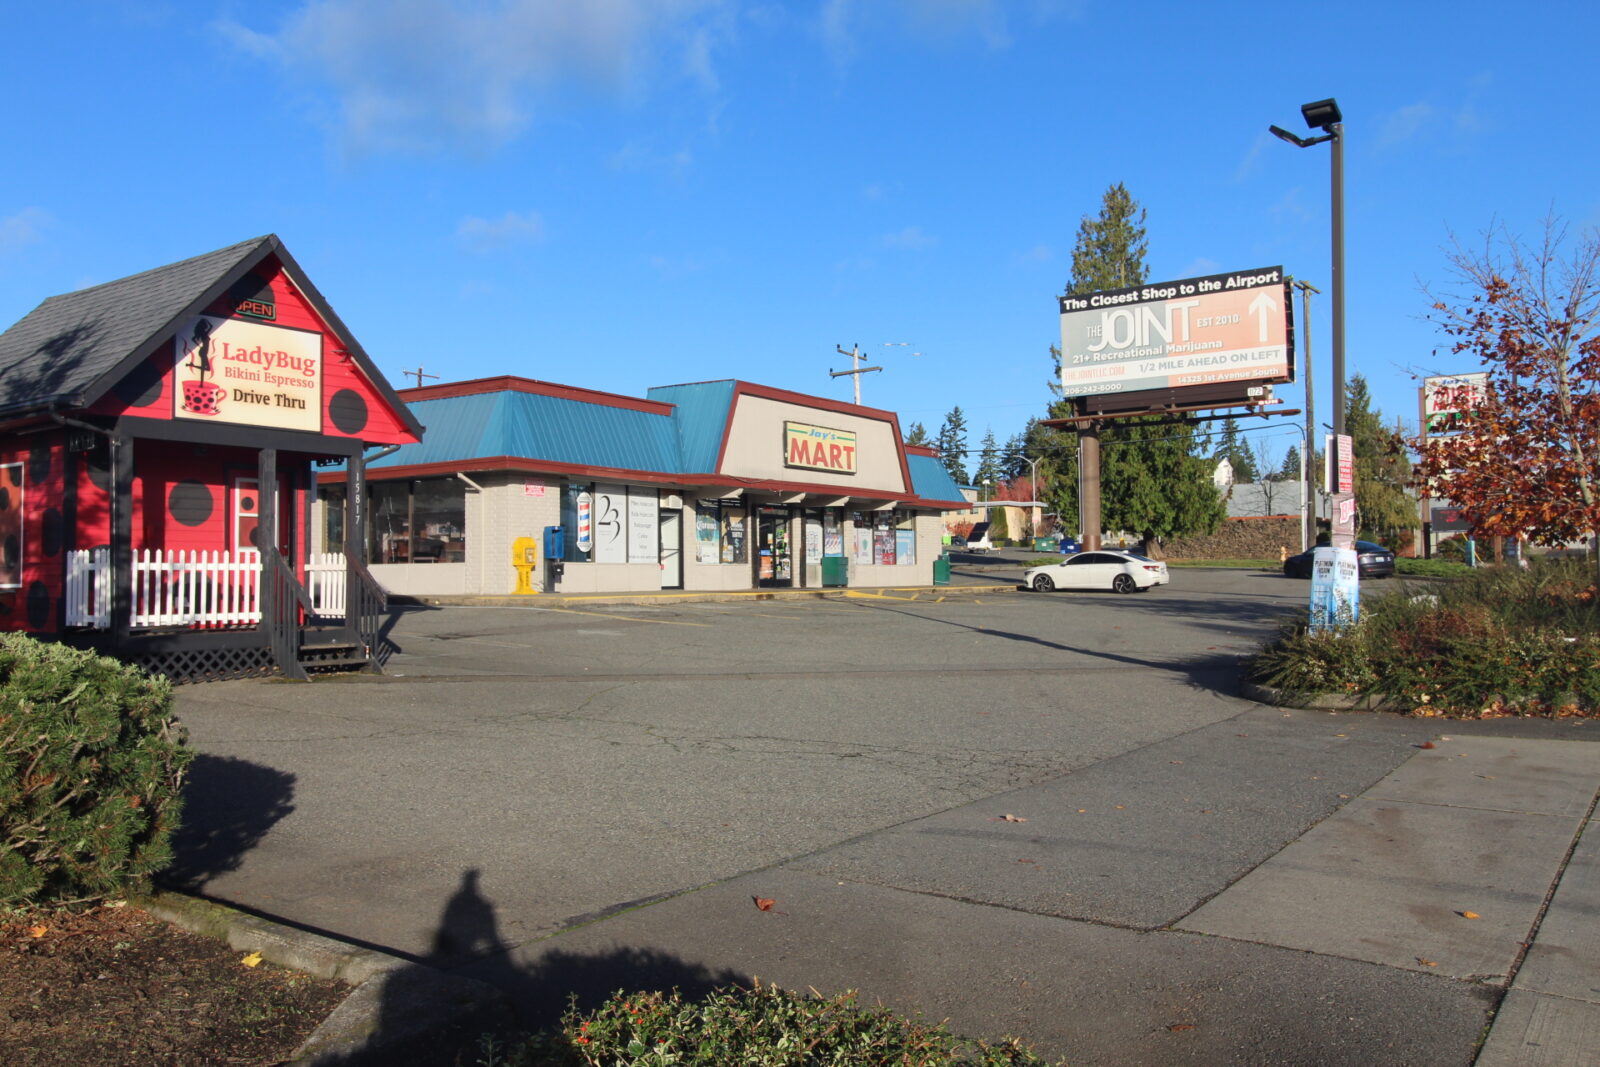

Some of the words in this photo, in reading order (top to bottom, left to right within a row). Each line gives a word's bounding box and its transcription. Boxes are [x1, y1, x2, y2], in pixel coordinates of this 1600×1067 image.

[1064, 298, 1088, 311] The
[1091, 291, 1139, 307] Closest
[1142, 286, 1177, 299] Shop
[1180, 284, 1195, 295] to
[1198, 280, 1222, 292] the
[1225, 270, 1279, 288] Airport
[1087, 300, 1200, 352] JOINT
[1087, 324, 1102, 338] THE
[1196, 317, 1213, 328] EST
[1215, 313, 1240, 325] 2010
[222, 342, 316, 377] LadyBug
[1072, 354, 1090, 364] 21+
[1093, 344, 1163, 362] Recreational
[1165, 340, 1223, 354] Marijuana
[1140, 362, 1156, 373] 1/2
[1158, 359, 1184, 371] MILE
[1187, 355, 1227, 368] AHEAD
[1230, 352, 1248, 362] ON
[1251, 349, 1281, 361] LEFT
[224, 366, 261, 382] Bikini
[264, 371, 315, 389] Espresso
[233, 388, 271, 406] Drive
[274, 393, 307, 410] Thru
[808, 428, 838, 441] Jay's
[790, 437, 855, 470] MART
[598, 495, 621, 544] 23
